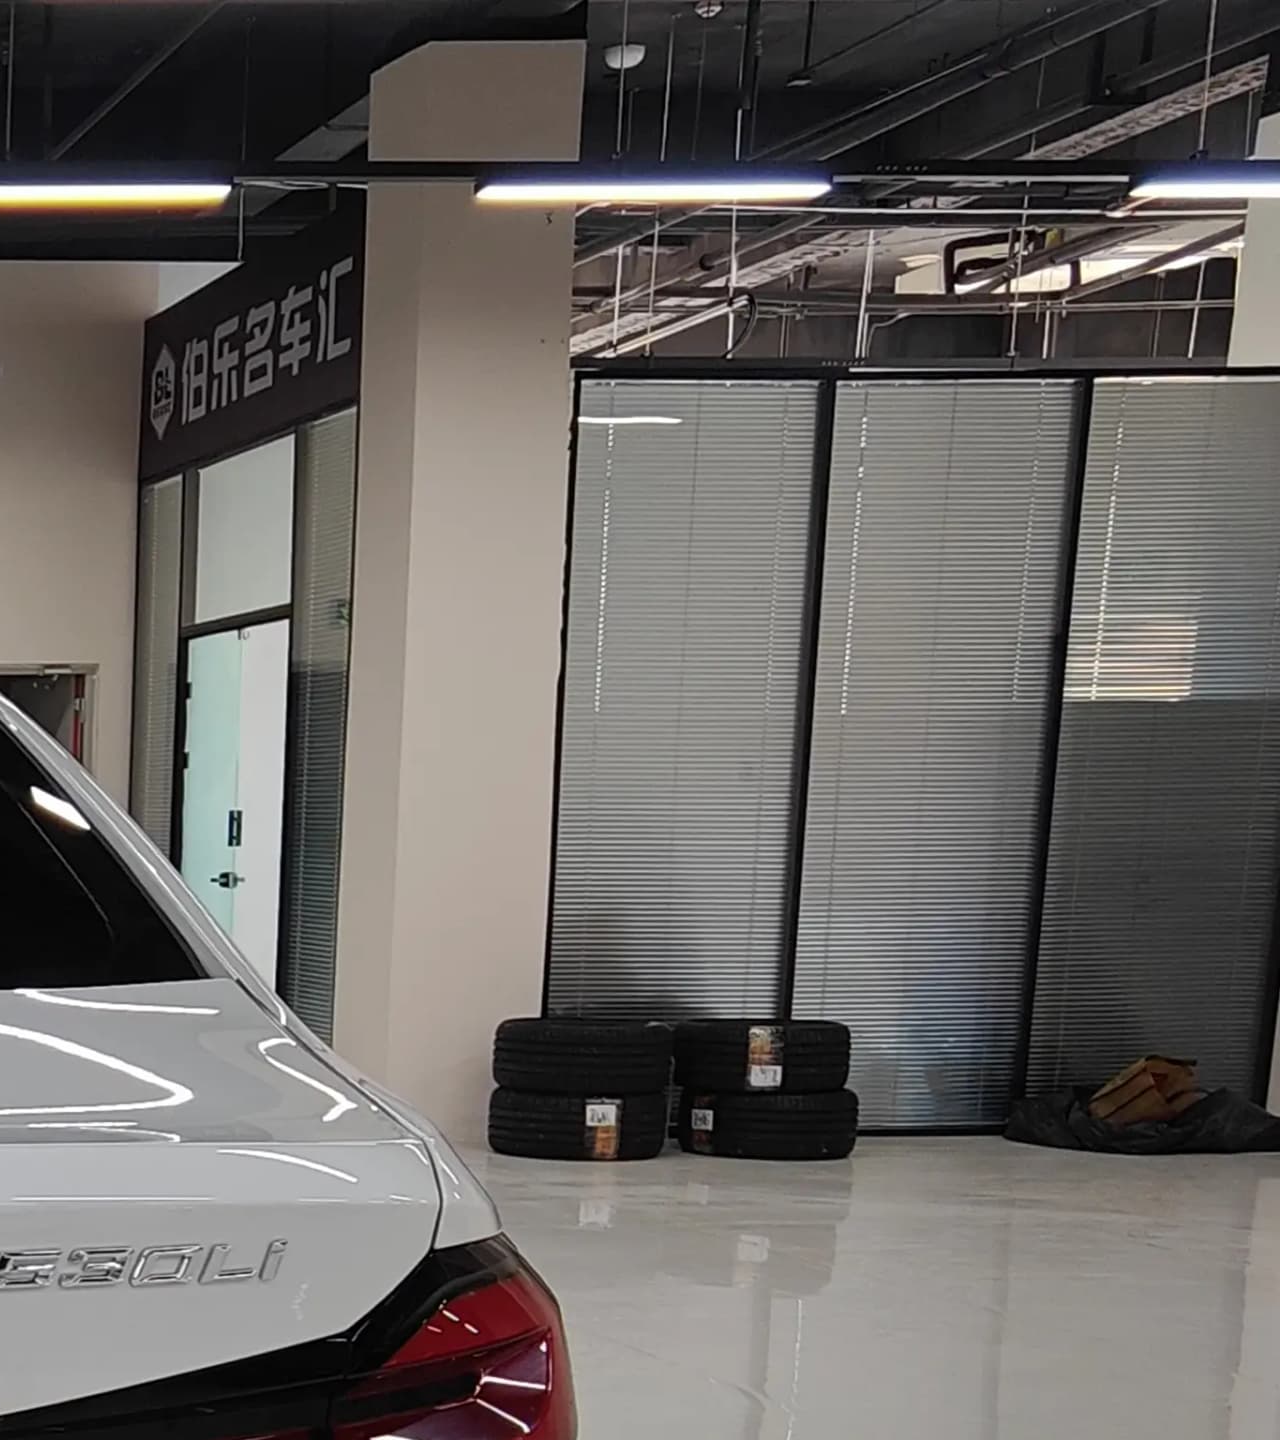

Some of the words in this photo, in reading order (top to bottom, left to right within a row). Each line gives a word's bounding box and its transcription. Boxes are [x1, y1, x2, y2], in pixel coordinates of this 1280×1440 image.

[181, 256, 353, 426] 伯乐名车汇
